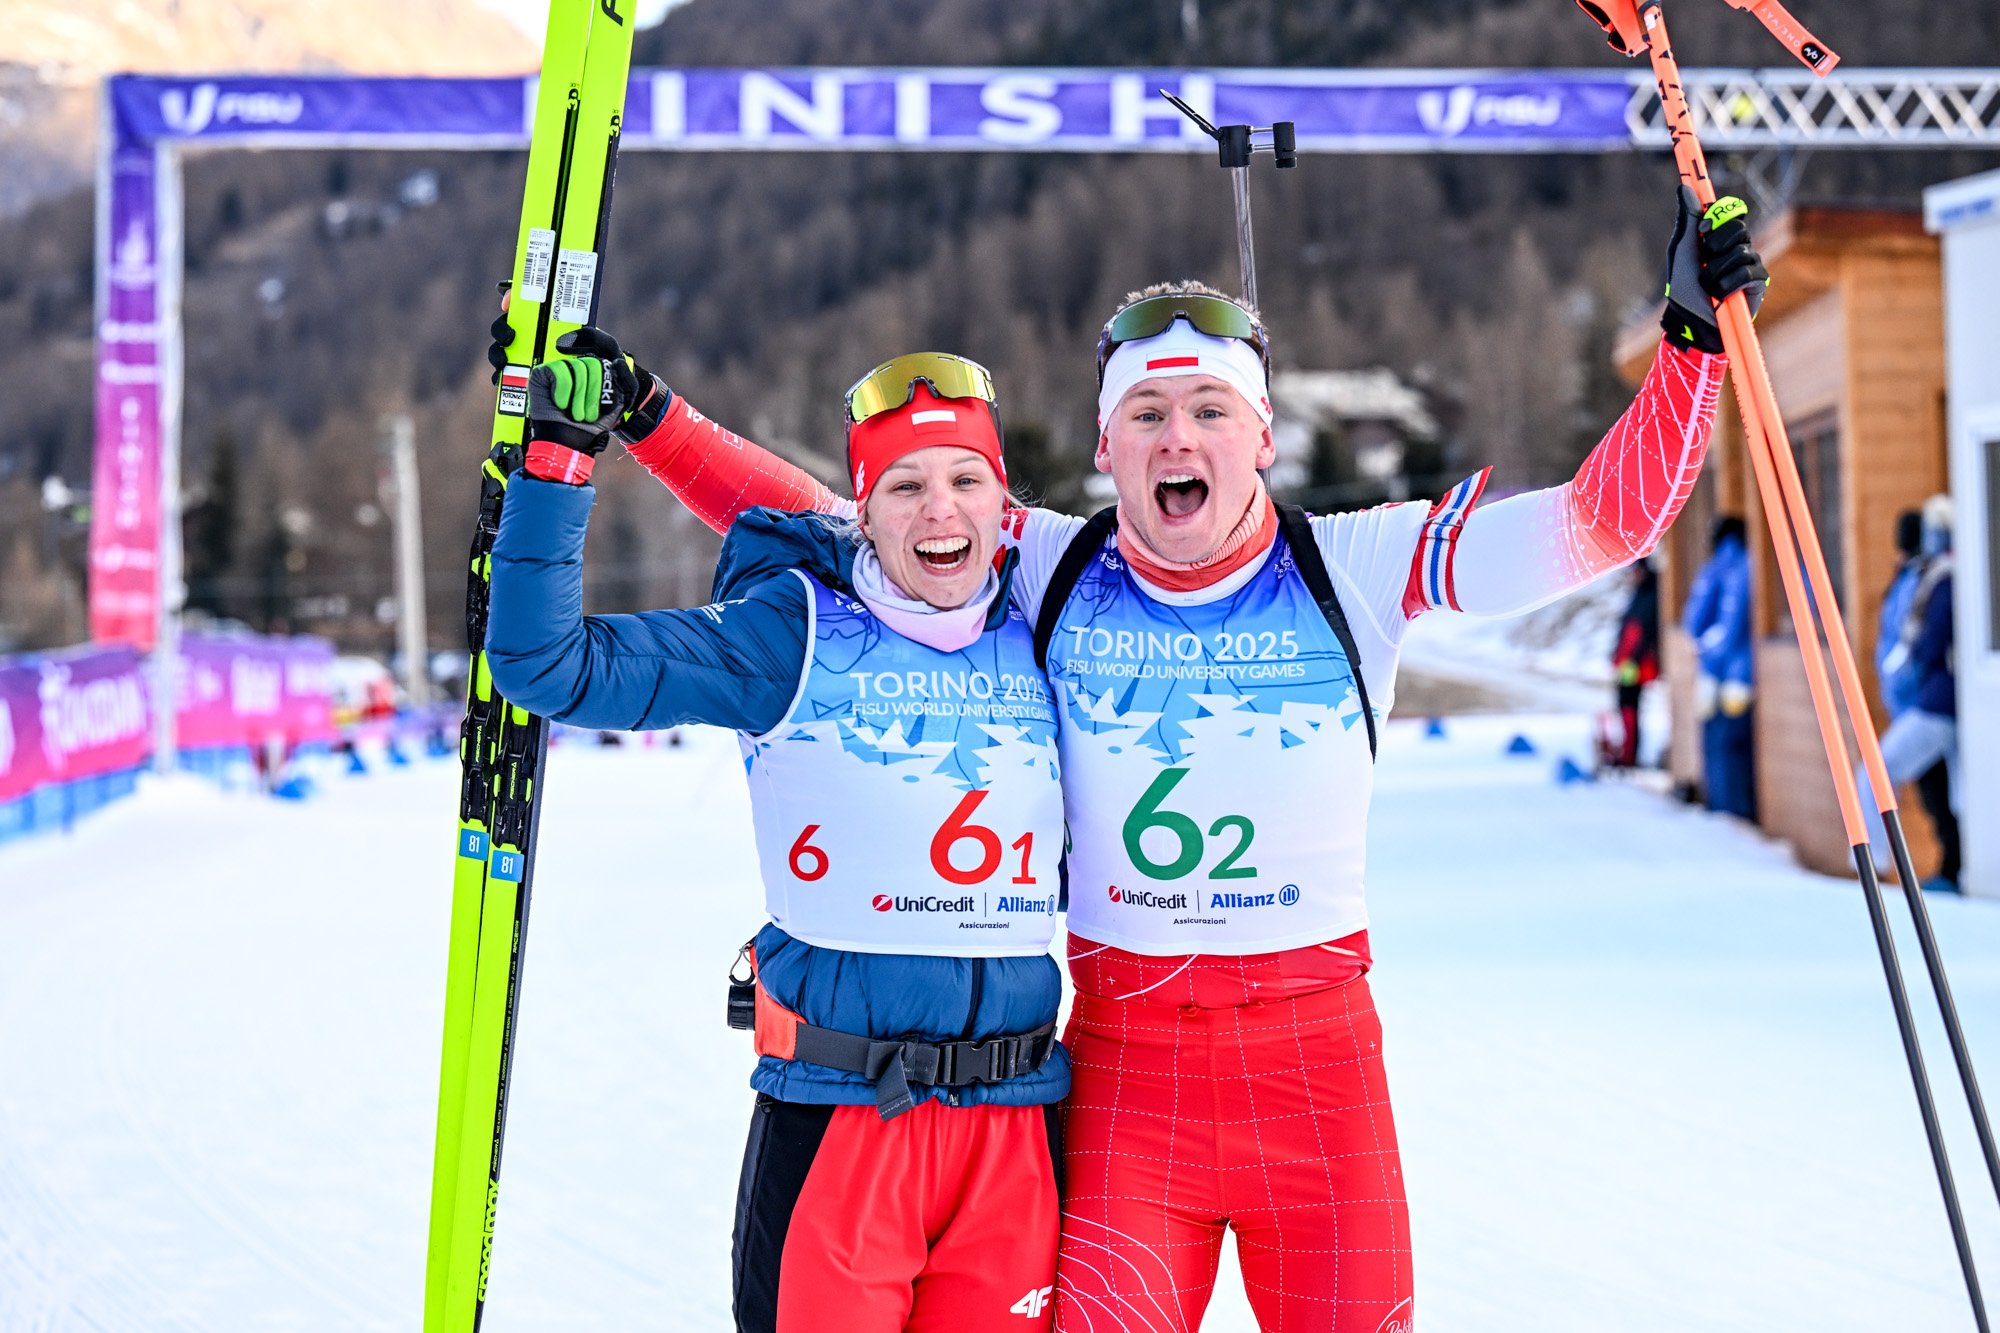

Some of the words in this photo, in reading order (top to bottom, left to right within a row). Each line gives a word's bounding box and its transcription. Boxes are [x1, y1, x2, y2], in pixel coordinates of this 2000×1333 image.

[523, 71, 1217, 143] INISH
[1069, 626, 1203, 662] TORINO
[1213, 630, 1300, 662] 2025
[1066, 659, 1094, 675] FISU
[1095, 662, 1155, 679] WORLD
[1157, 665, 1249, 680] UNIVERSITY
[1249, 663, 1306, 679] GAMES
[850, 671, 994, 699] TORINO
[1001, 673, 1047, 705] 2025
[852, 703, 889, 716] FISU
[891, 702, 954, 716] WORLD
[956, 704, 1031, 719] UNIVERSITY
[469, 835, 480, 853] 81
[789, 824, 829, 881] 6
[501, 856, 514, 875] 81
[896, 896, 975, 912] UniCredit
[996, 896, 1046, 913] Allianz
[1122, 889, 1187, 909] UniCredit
[1210, 893, 1275, 909] Allianz
[958, 922, 1010, 930] Assicurazioni
[1173, 917, 1227, 926] Assicurazioni
[1009, 1284, 1054, 1319] 4F
